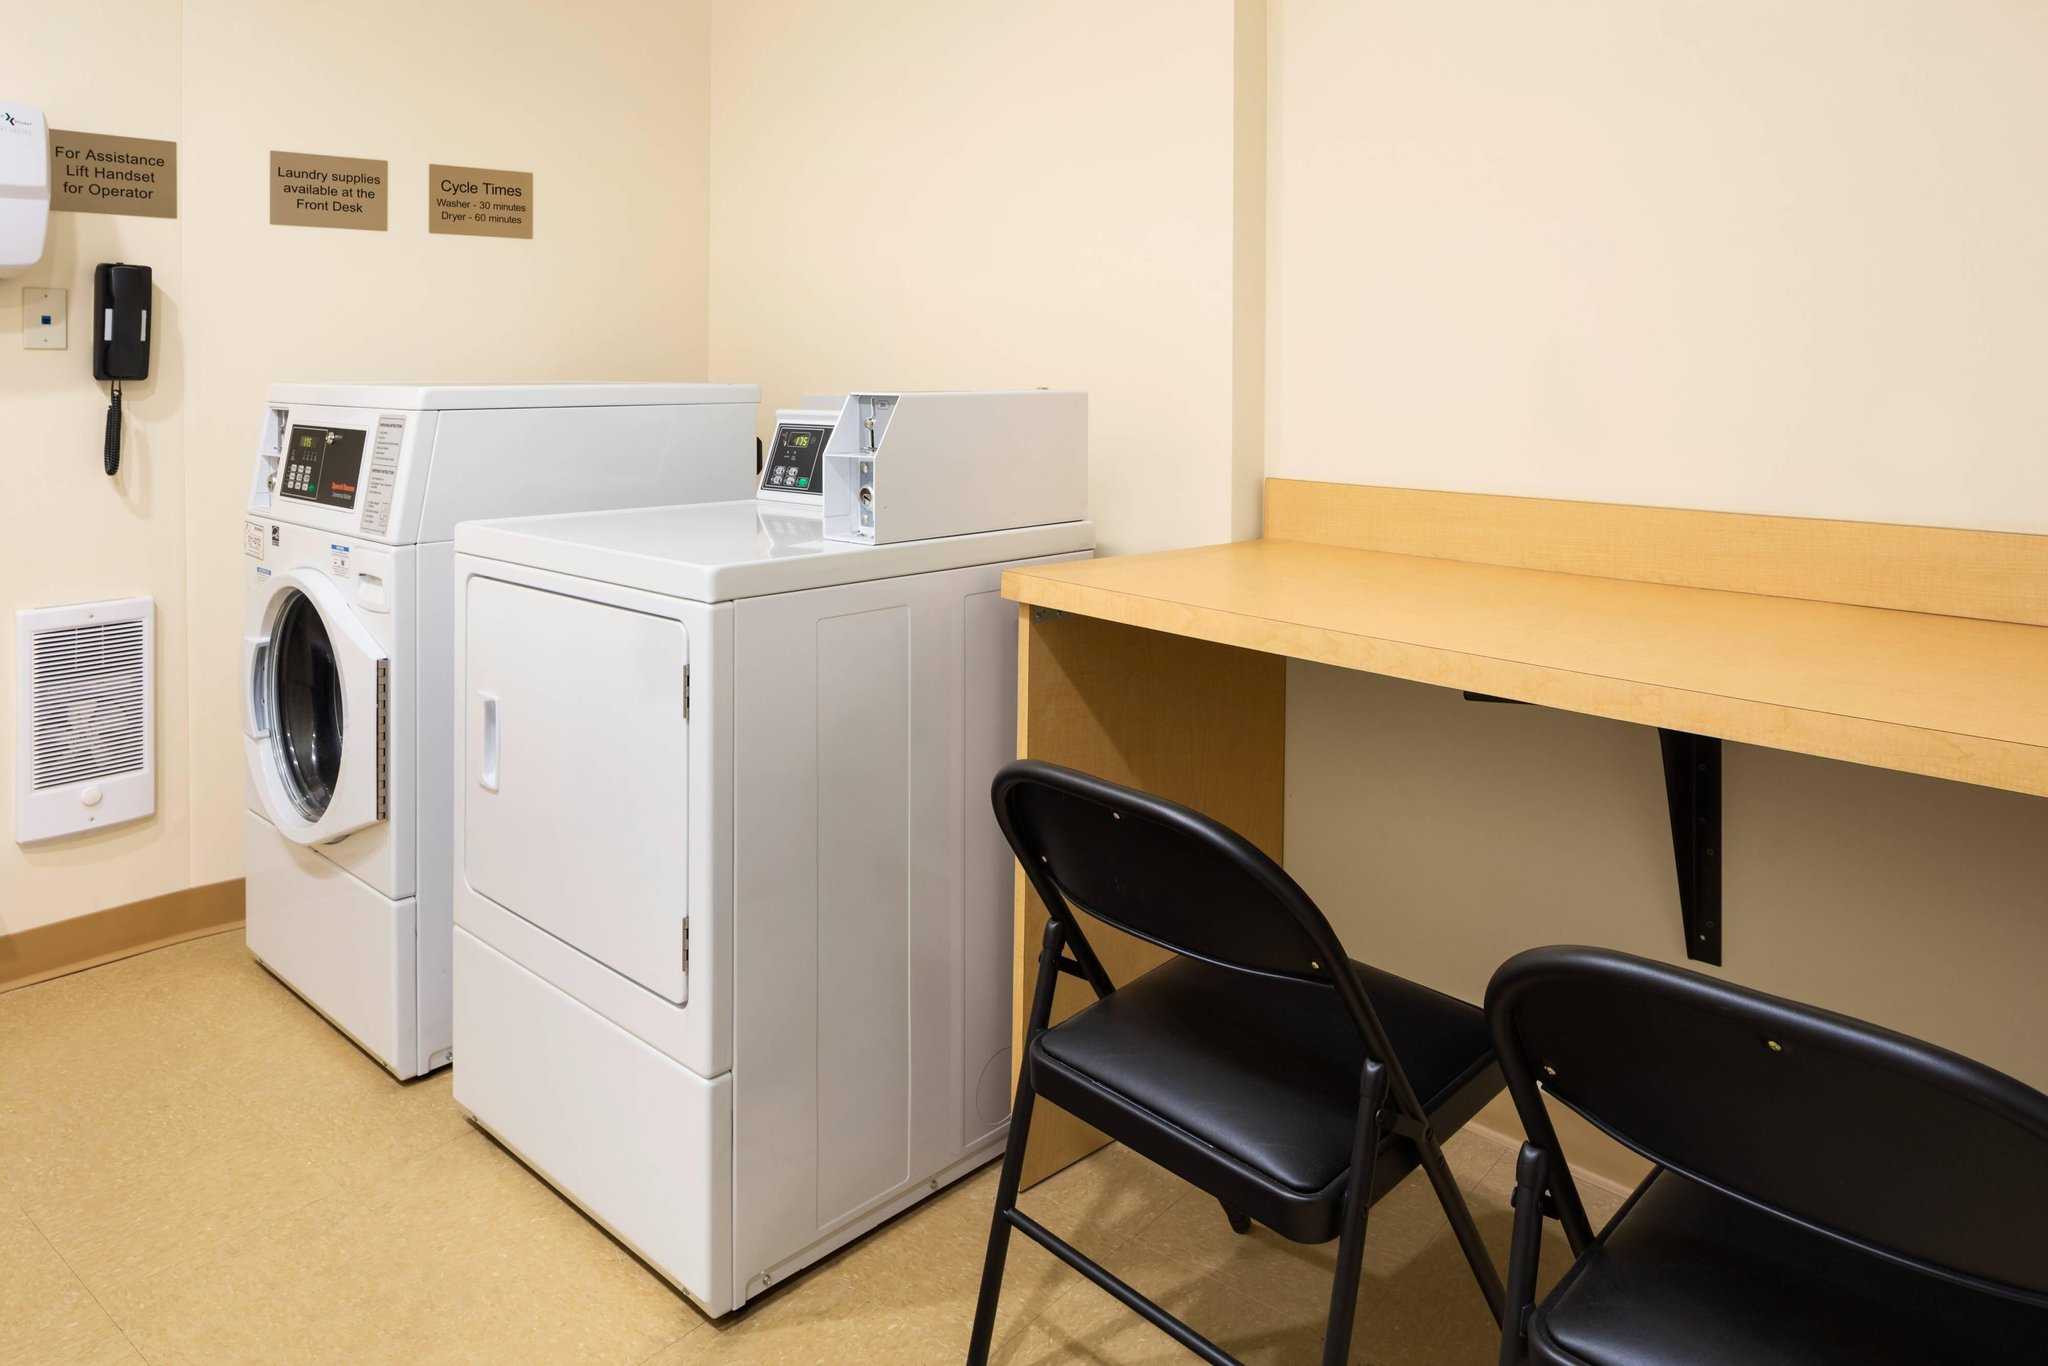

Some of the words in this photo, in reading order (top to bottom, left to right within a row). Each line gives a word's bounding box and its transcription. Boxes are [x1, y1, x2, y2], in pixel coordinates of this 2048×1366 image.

[55, 146, 81, 159] For
[85, 149, 165, 167] Assistance
[66, 165, 90, 178] Lift
[95, 167, 155, 183] Handset
[277, 166, 328, 183] Laundry
[331, 173, 381, 185] supplies
[63, 181, 83, 194] for
[88, 183, 154, 200] Operator
[283, 184, 338, 197] available
[341, 188, 353, 198] at
[356, 188, 376, 199] the
[440, 179, 478, 195] Cycle
[482, 182, 522, 197] Times
[296, 198, 328, 211] Front
[332, 201, 364, 213] Desk
[436, 198, 471, 209] Washer
[479, 200, 490, 210] 30
[493, 202, 526, 212] minutes
[441, 211, 466, 223] Dryer
[474, 213, 486, 222] 60
[488, 214, 522, 224] minutes
